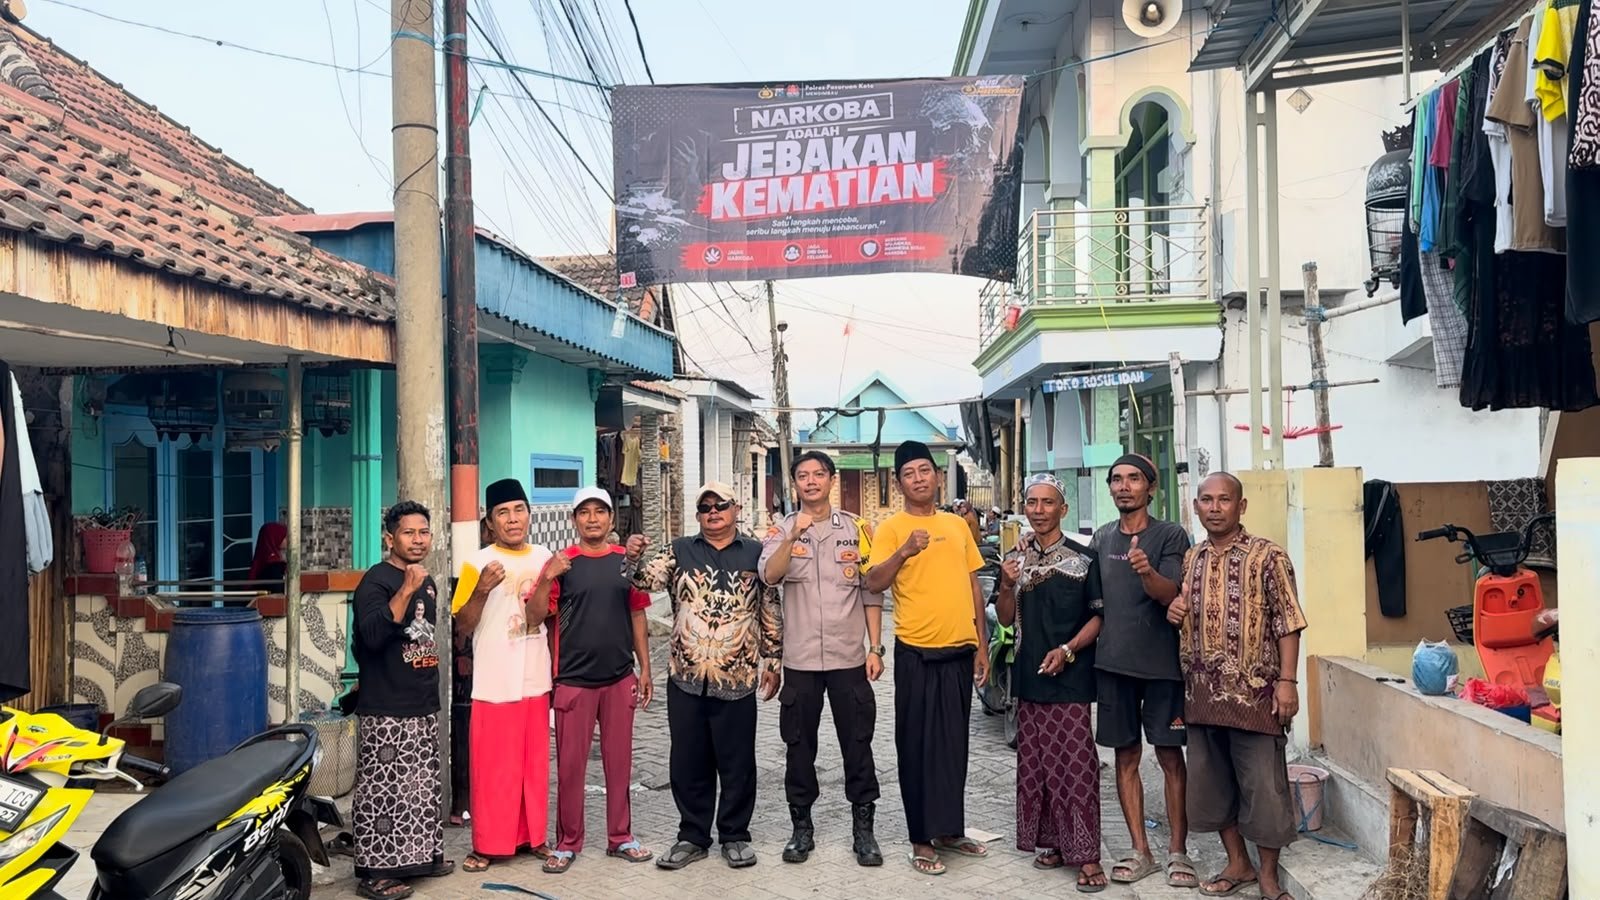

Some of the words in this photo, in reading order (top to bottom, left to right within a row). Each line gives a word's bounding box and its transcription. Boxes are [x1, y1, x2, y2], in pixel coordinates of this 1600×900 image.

[751, 99, 881, 129] NARKOBA
[785, 126, 840, 141] ADALAH
[722, 130, 917, 181] JEBAKAN
[711, 162, 935, 220] KEMATIAN
[746, 226, 770, 236] seribu
[770, 225, 801, 236] langkah
[802, 224, 831, 234] menuju
[790, 217, 821, 228] langkah
[1046, 377, 1080, 392] TOKO
[836, 539, 860, 547] POLR
[0, 810, 16, 821] 27
